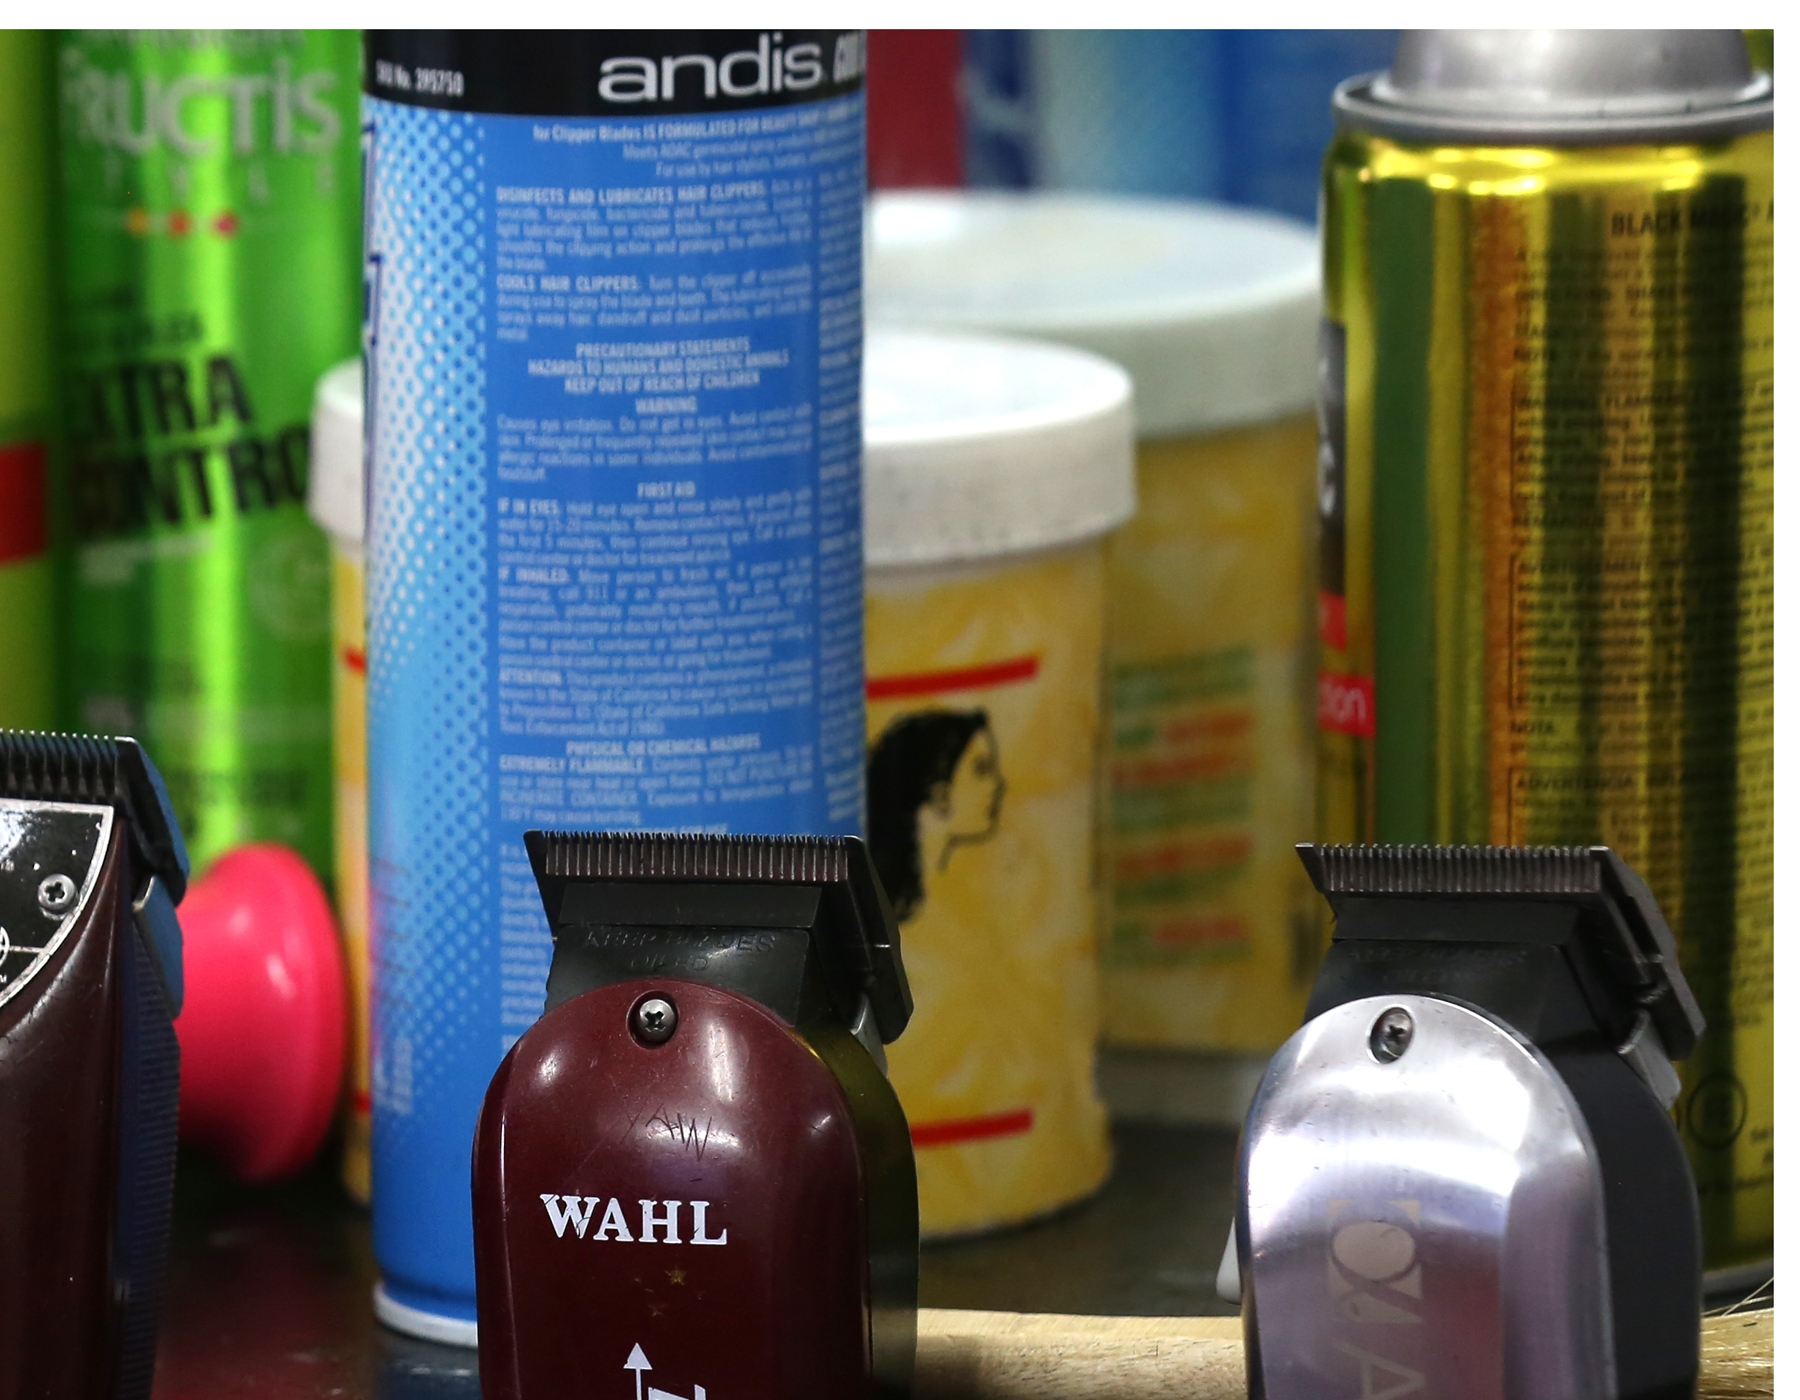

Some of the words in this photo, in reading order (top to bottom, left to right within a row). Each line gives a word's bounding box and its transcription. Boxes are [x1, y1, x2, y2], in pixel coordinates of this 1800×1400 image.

[598, 33, 822, 102] andis
[552, 124, 596, 143] Clipper
[599, 125, 641, 142] Blades
[643, 124, 655, 141] IS
[658, 119, 737, 138] FORMULATED
[738, 117, 759, 135] FOR
[496, 186, 564, 205] DISINFECTS
[569, 187, 595, 205] AND
[599, 187, 674, 205] LUBRICATES
[678, 185, 707, 202] HAIR
[496, 274, 536, 292] COOLS
[541, 275, 571, 292] HAIR
[576, 342, 677, 358] PRECAUTIONARY
[679, 336, 749, 356] STATEMENTS
[528, 359, 583, 377] HAZARDS
[586, 360, 601, 375] TO
[603, 358, 656, 376] HUMANS
[659, 358, 684, 374] AND
[686, 353, 744, 372] DOMESTIC
[565, 377, 596, 394] KEEP
[599, 377, 622, 393] OUT
[625, 376, 641, 392] OF
[644, 376, 684, 393] REACH
[686, 372, 701, 391] OF
[635, 395, 698, 414] WARNING
[637, 481, 672, 499] FIRST
[674, 480, 696, 497] AID
[498, 497, 510, 512] IF
[512, 498, 526, 514] IN
[498, 565, 510, 582] IF
[566, 740, 624, 756] PHYSICAL
[627, 740, 646, 755] OR
[539, 1194, 727, 1245] WAHL
